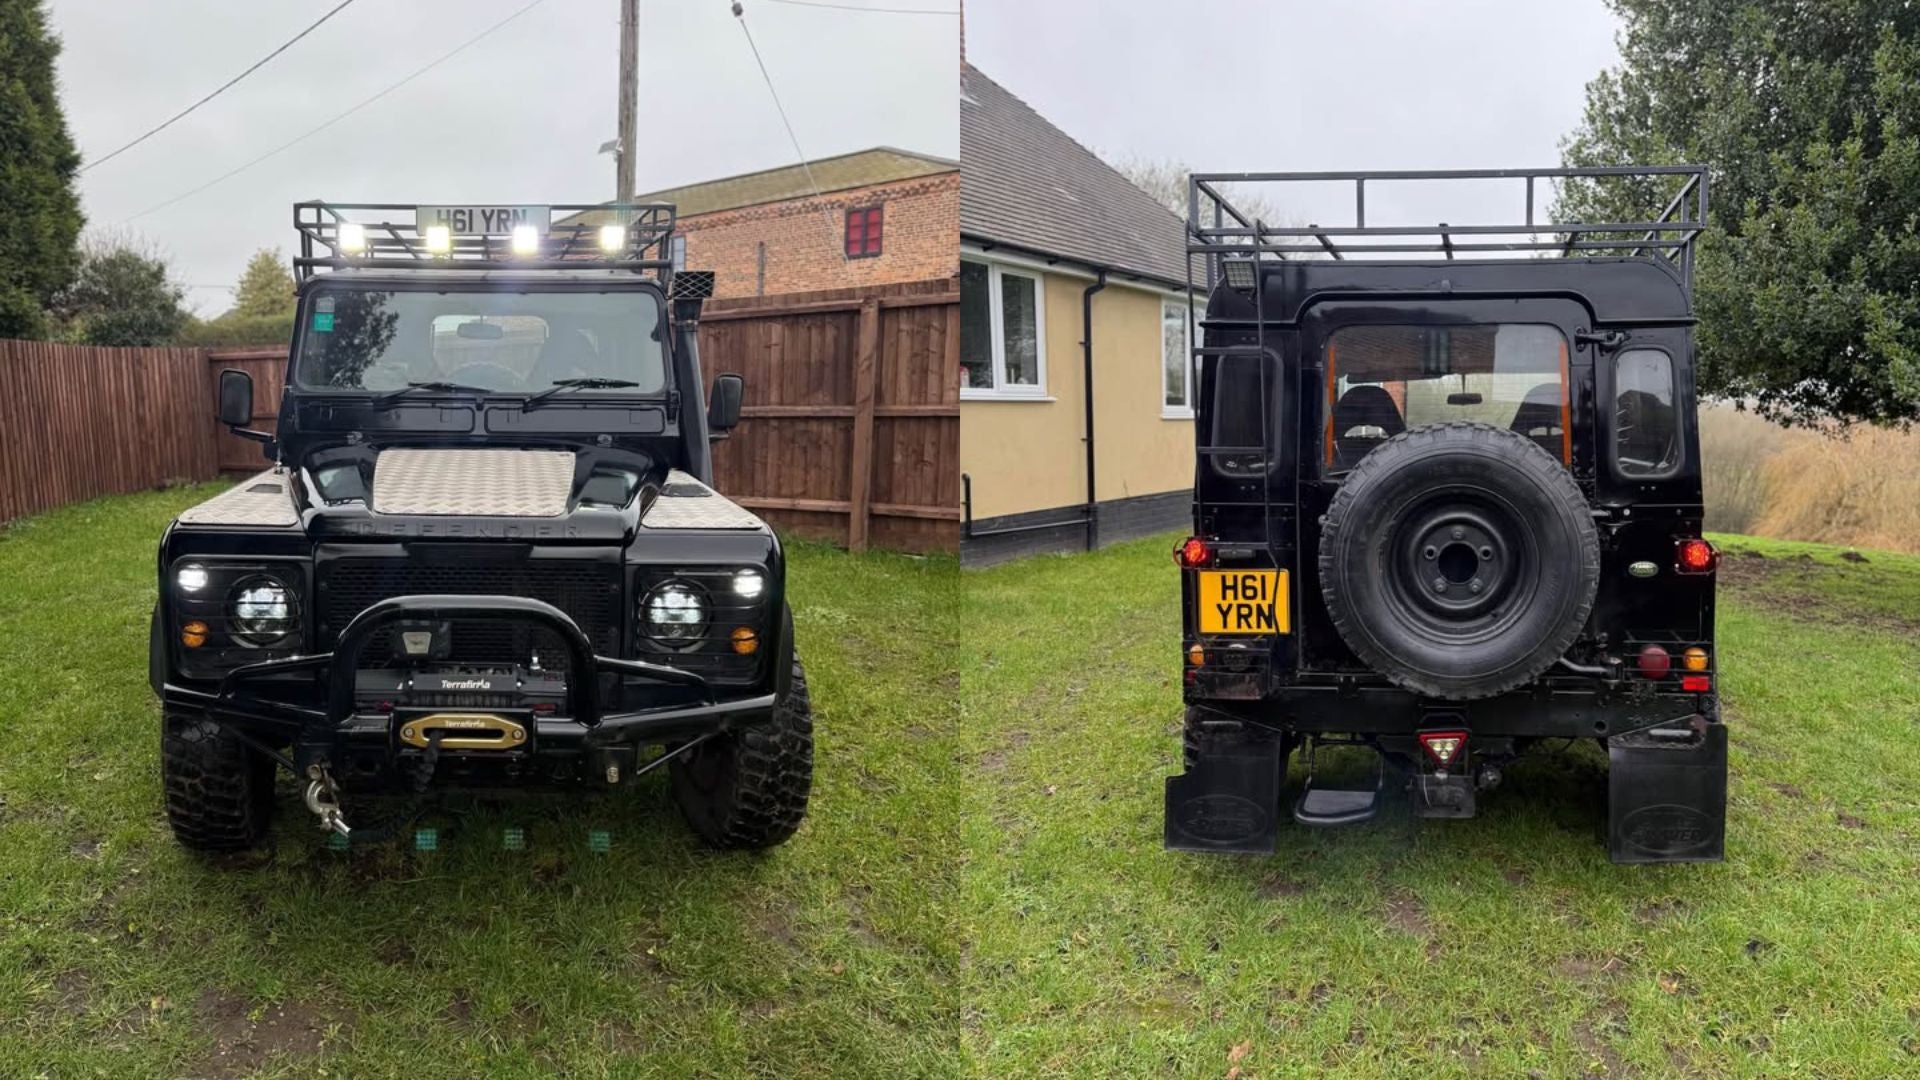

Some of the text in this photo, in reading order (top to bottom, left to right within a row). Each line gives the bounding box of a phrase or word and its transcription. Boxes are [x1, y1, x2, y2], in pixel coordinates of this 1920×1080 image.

[1221, 574, 1267, 600] H61
[1216, 603, 1273, 629] YRN
[441, 679, 490, 689] Terrafirma
